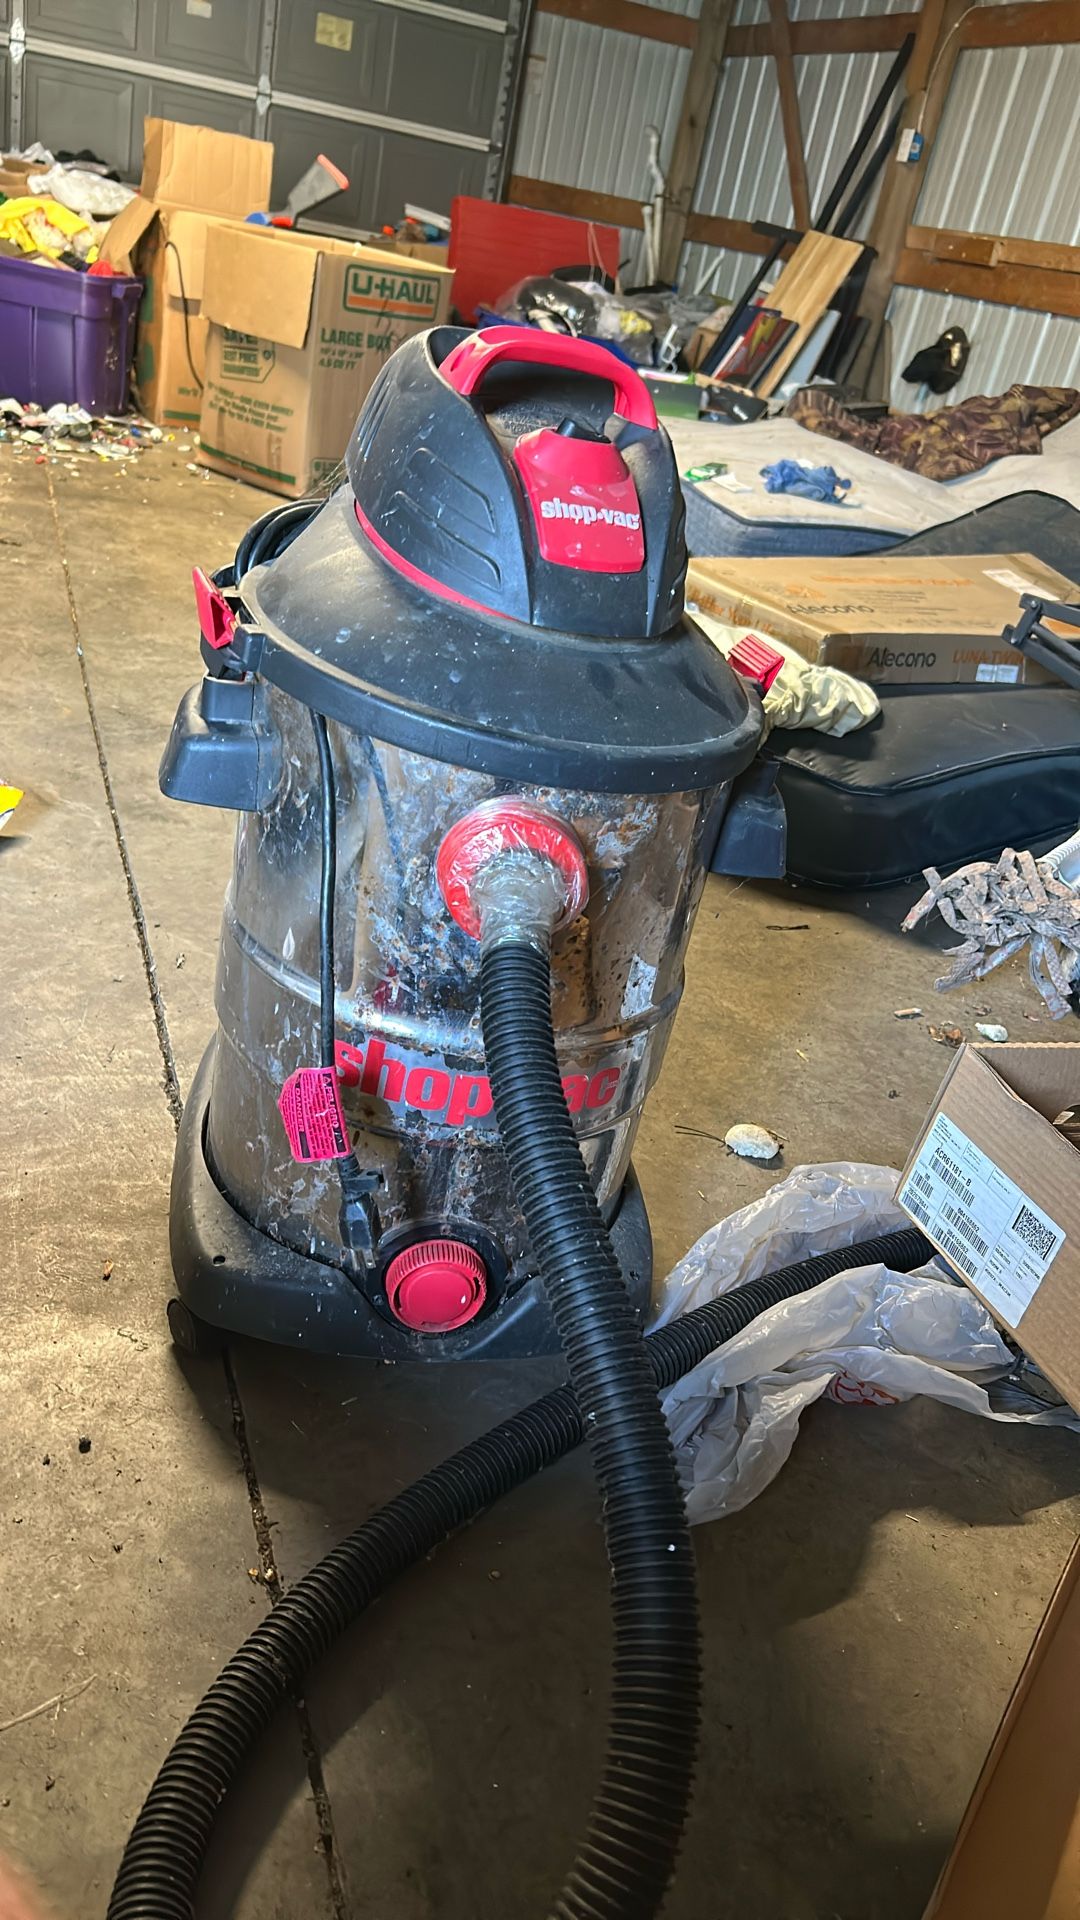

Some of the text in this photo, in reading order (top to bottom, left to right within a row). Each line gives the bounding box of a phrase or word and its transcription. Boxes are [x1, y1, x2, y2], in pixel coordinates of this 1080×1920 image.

[352, 273, 434, 304] U-HAUL
[321, 328, 363, 347] LARGE
[866, 648, 936, 667] Alecono
[295, 1087, 305, 1132] DANGER
[324, 1086, 340, 1129] PELIGRO
